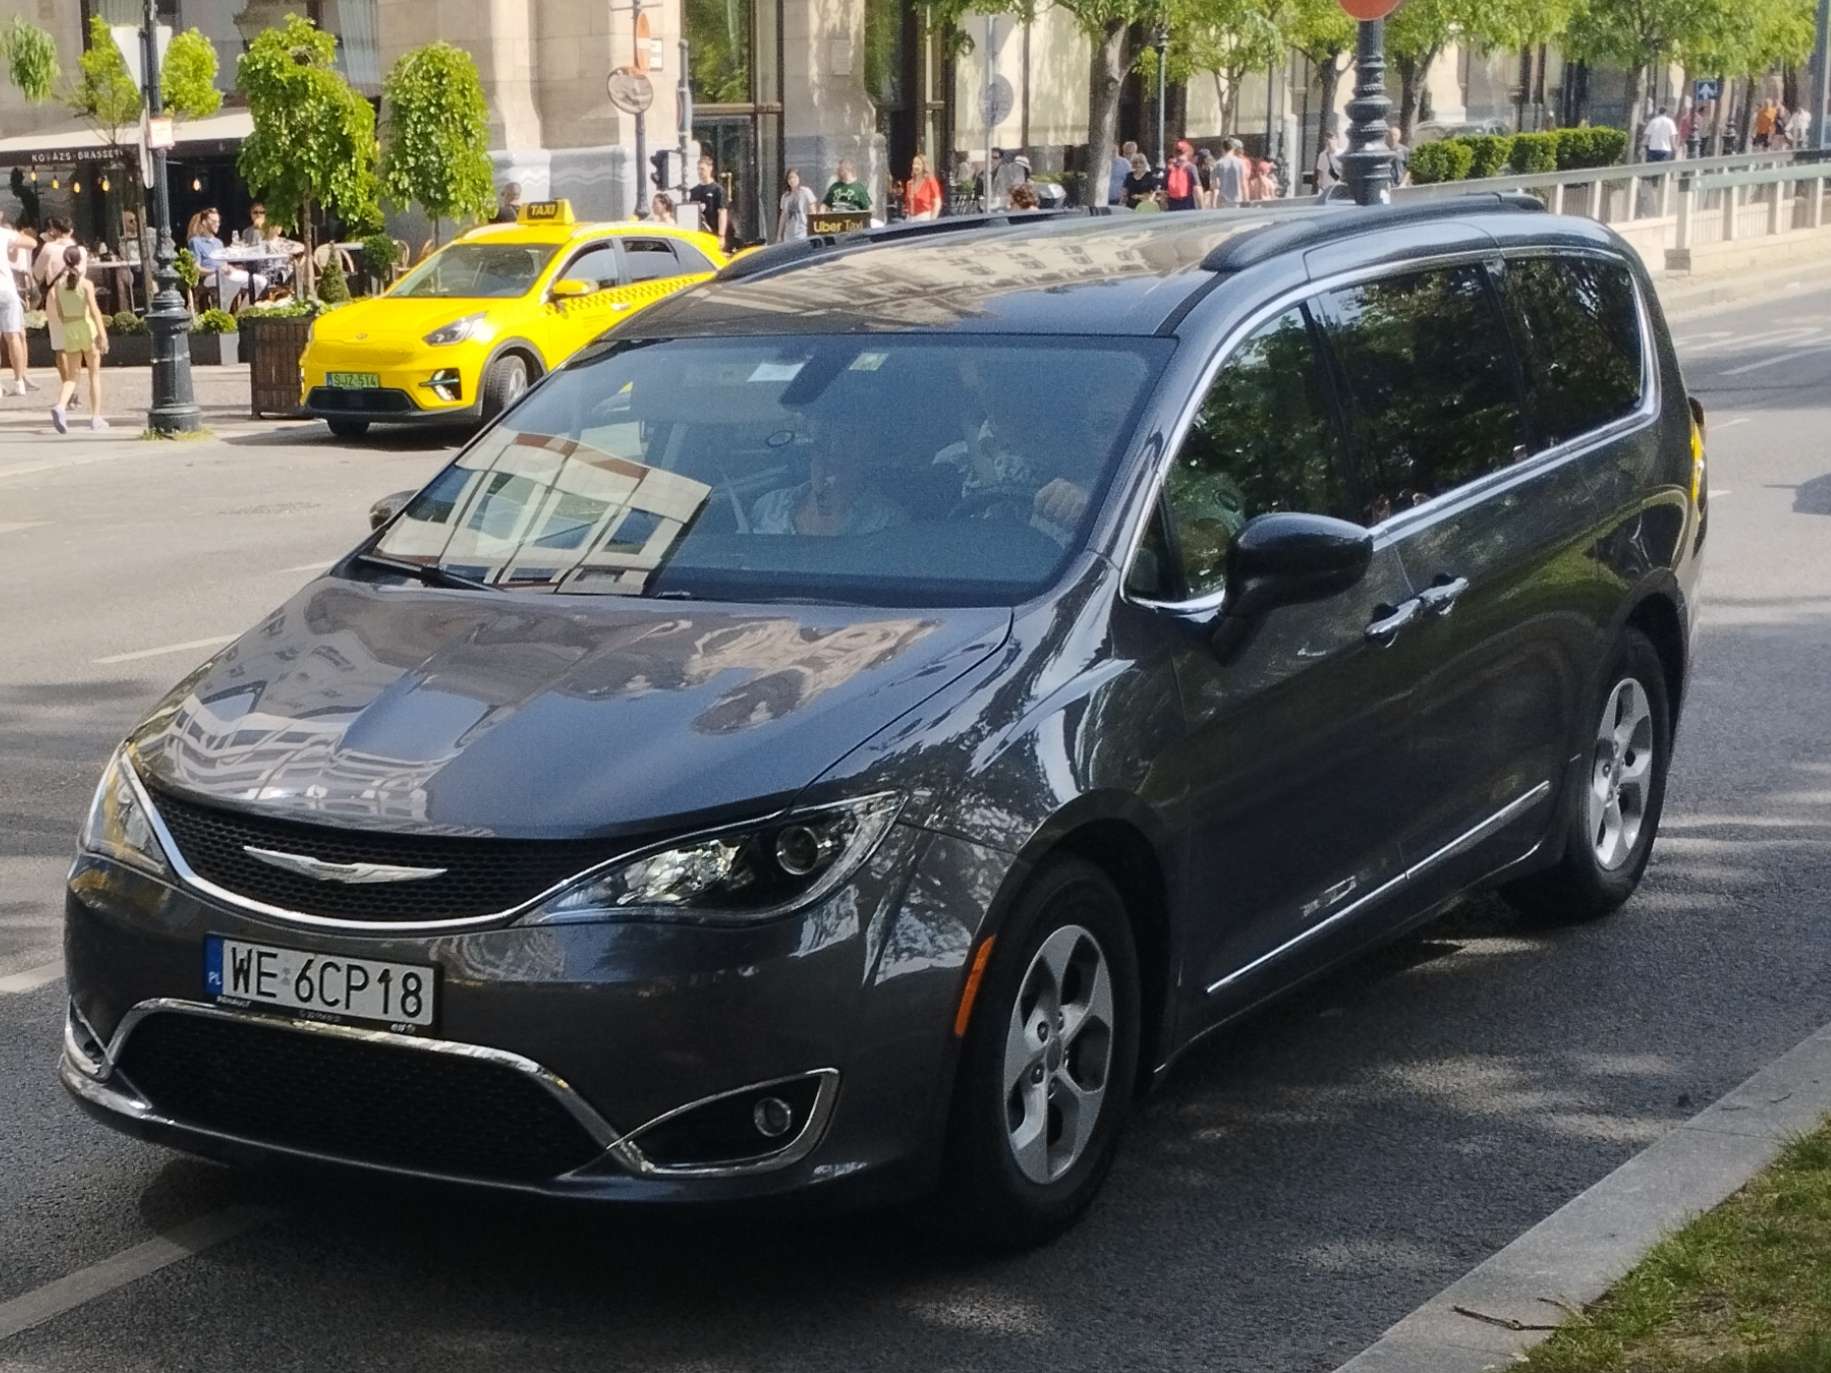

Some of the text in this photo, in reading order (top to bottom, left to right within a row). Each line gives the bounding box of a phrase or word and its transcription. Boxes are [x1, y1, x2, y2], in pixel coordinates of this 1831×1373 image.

[530, 204, 556, 216] TAXI
[813, 220, 842, 233] Uber
[208, 971, 221, 985] PL
[231, 947, 423, 1018] WE 6CP18
